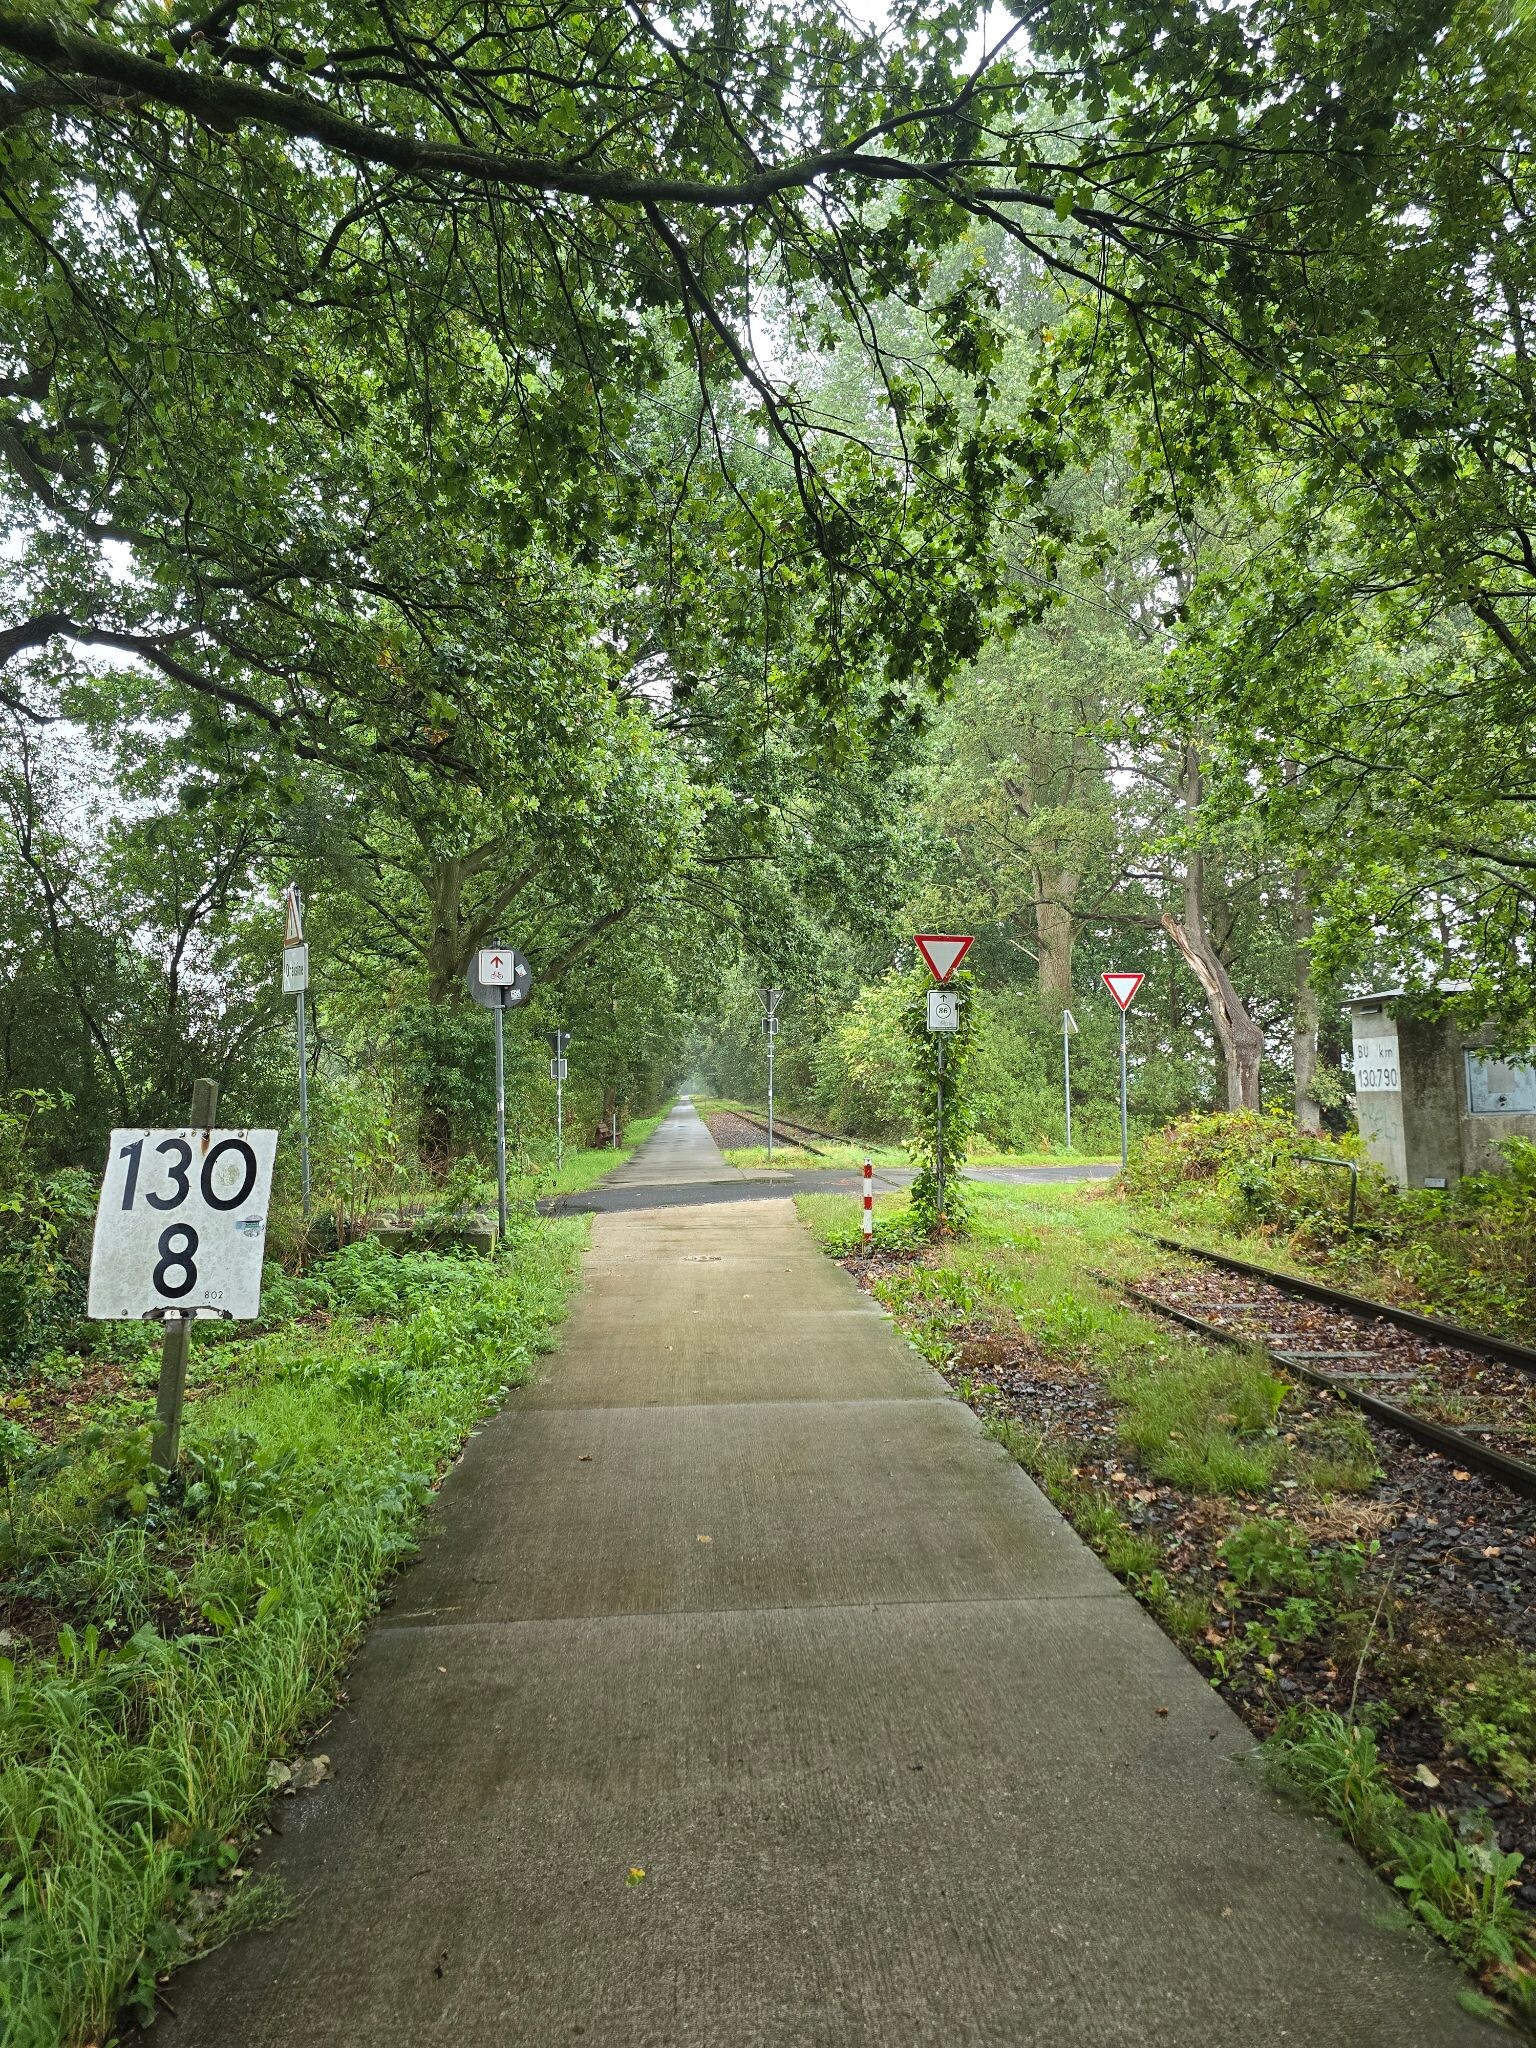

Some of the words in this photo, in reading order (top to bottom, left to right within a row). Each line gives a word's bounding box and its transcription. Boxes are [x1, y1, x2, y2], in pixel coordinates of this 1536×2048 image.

[1378, 1043, 1393, 1058] km
[119, 1138, 257, 1211] 130
[153, 1223, 199, 1299] 8
[204, 1290, 223, 1300] 802
